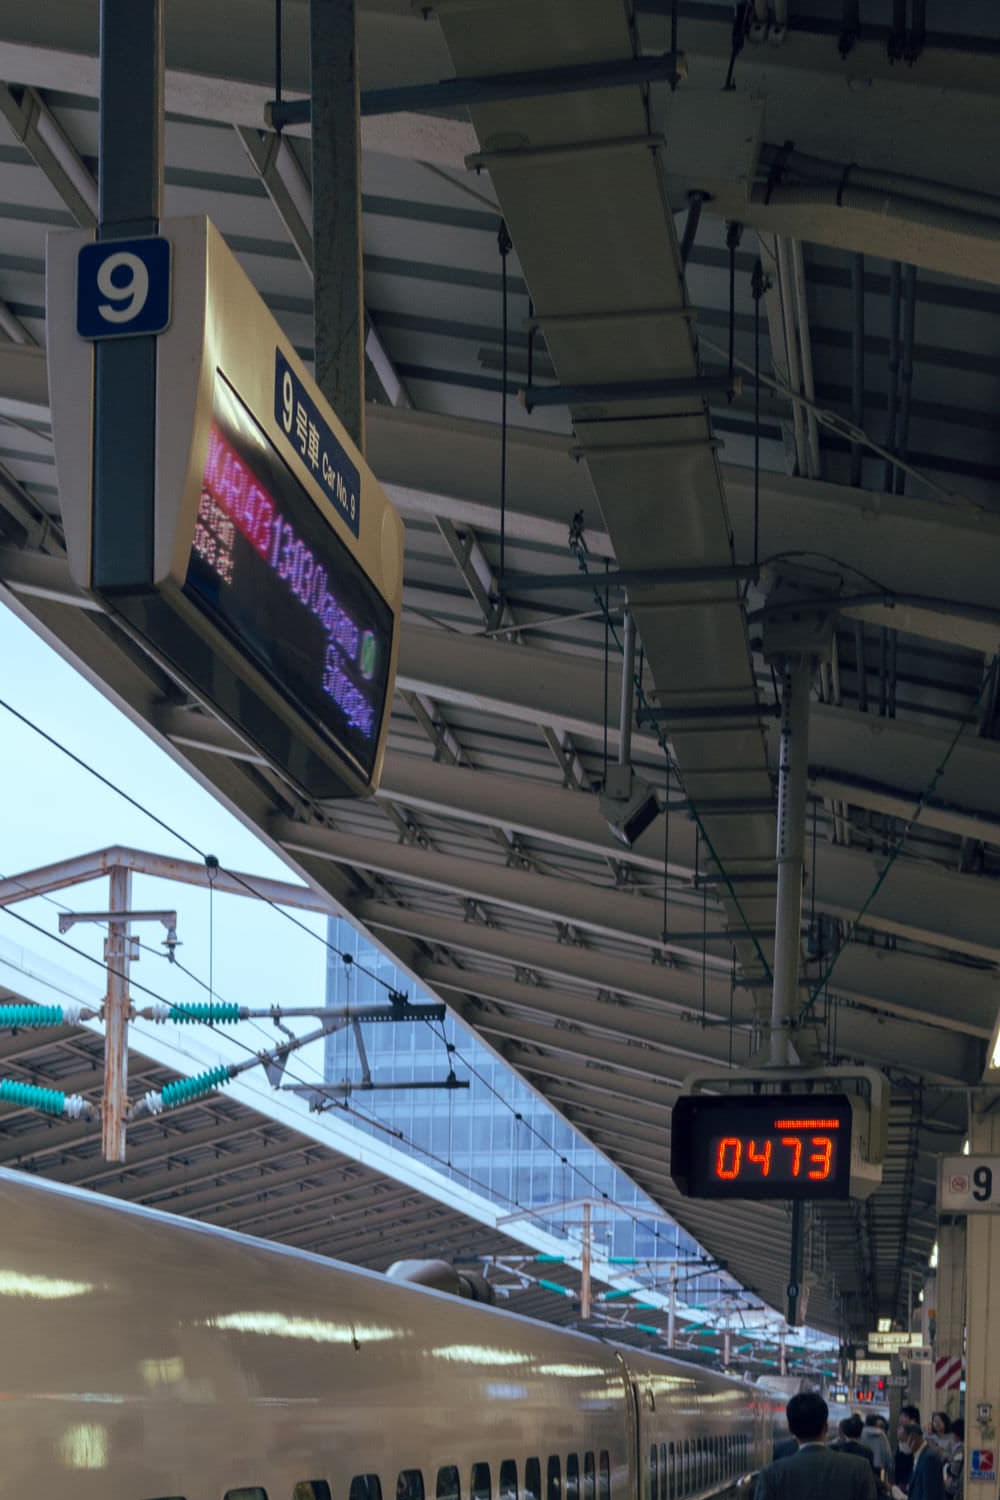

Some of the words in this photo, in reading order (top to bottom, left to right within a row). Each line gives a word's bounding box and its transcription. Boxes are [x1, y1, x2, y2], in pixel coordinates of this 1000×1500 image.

[96, 251, 149, 324] 9
[322, 452, 336, 491] Car
[336, 475, 349, 511] No.
[350, 493, 356, 521] 9
[715, 1136, 833, 1181] 0473
[973, 1166, 993, 1202] 9
